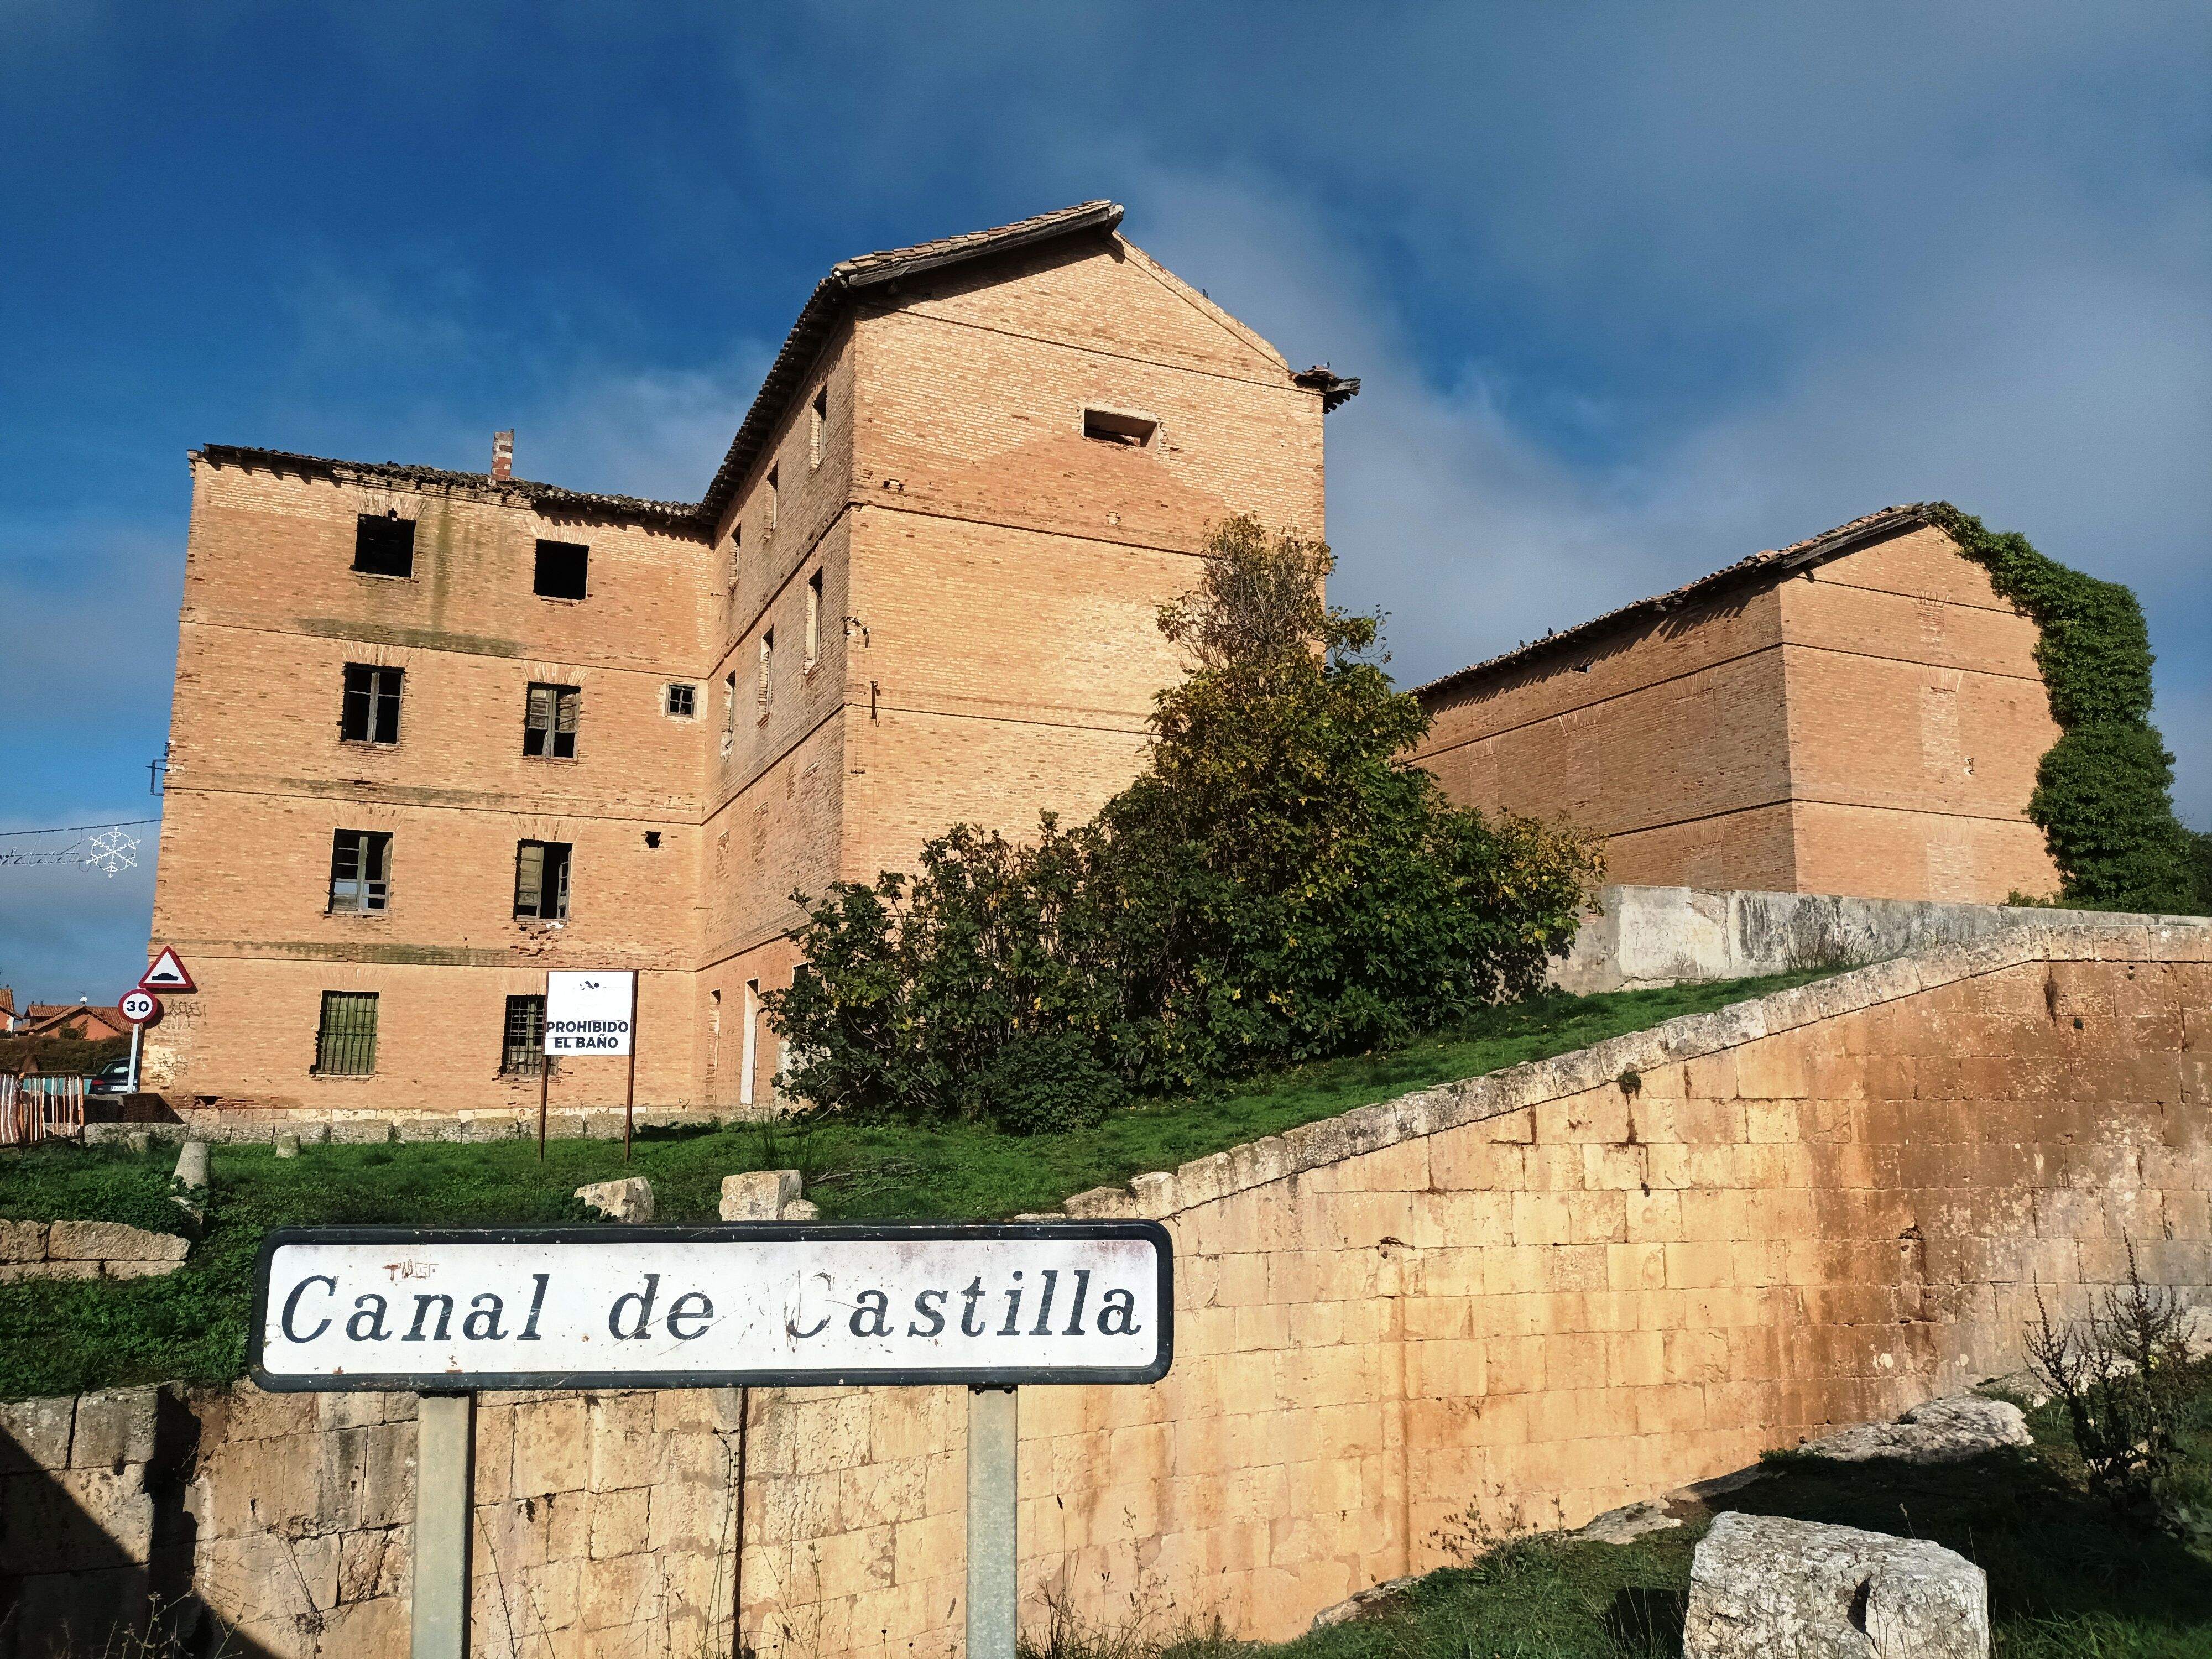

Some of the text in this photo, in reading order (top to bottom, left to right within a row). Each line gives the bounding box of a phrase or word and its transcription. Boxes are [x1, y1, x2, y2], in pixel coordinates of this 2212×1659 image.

[126, 1000, 149, 1013] 30
[546, 1021, 629, 1033] PROHIBIDO
[555, 1033, 618, 1048] EL BAÑO
[281, 1270, 1142, 1344] Canal de Castilla
